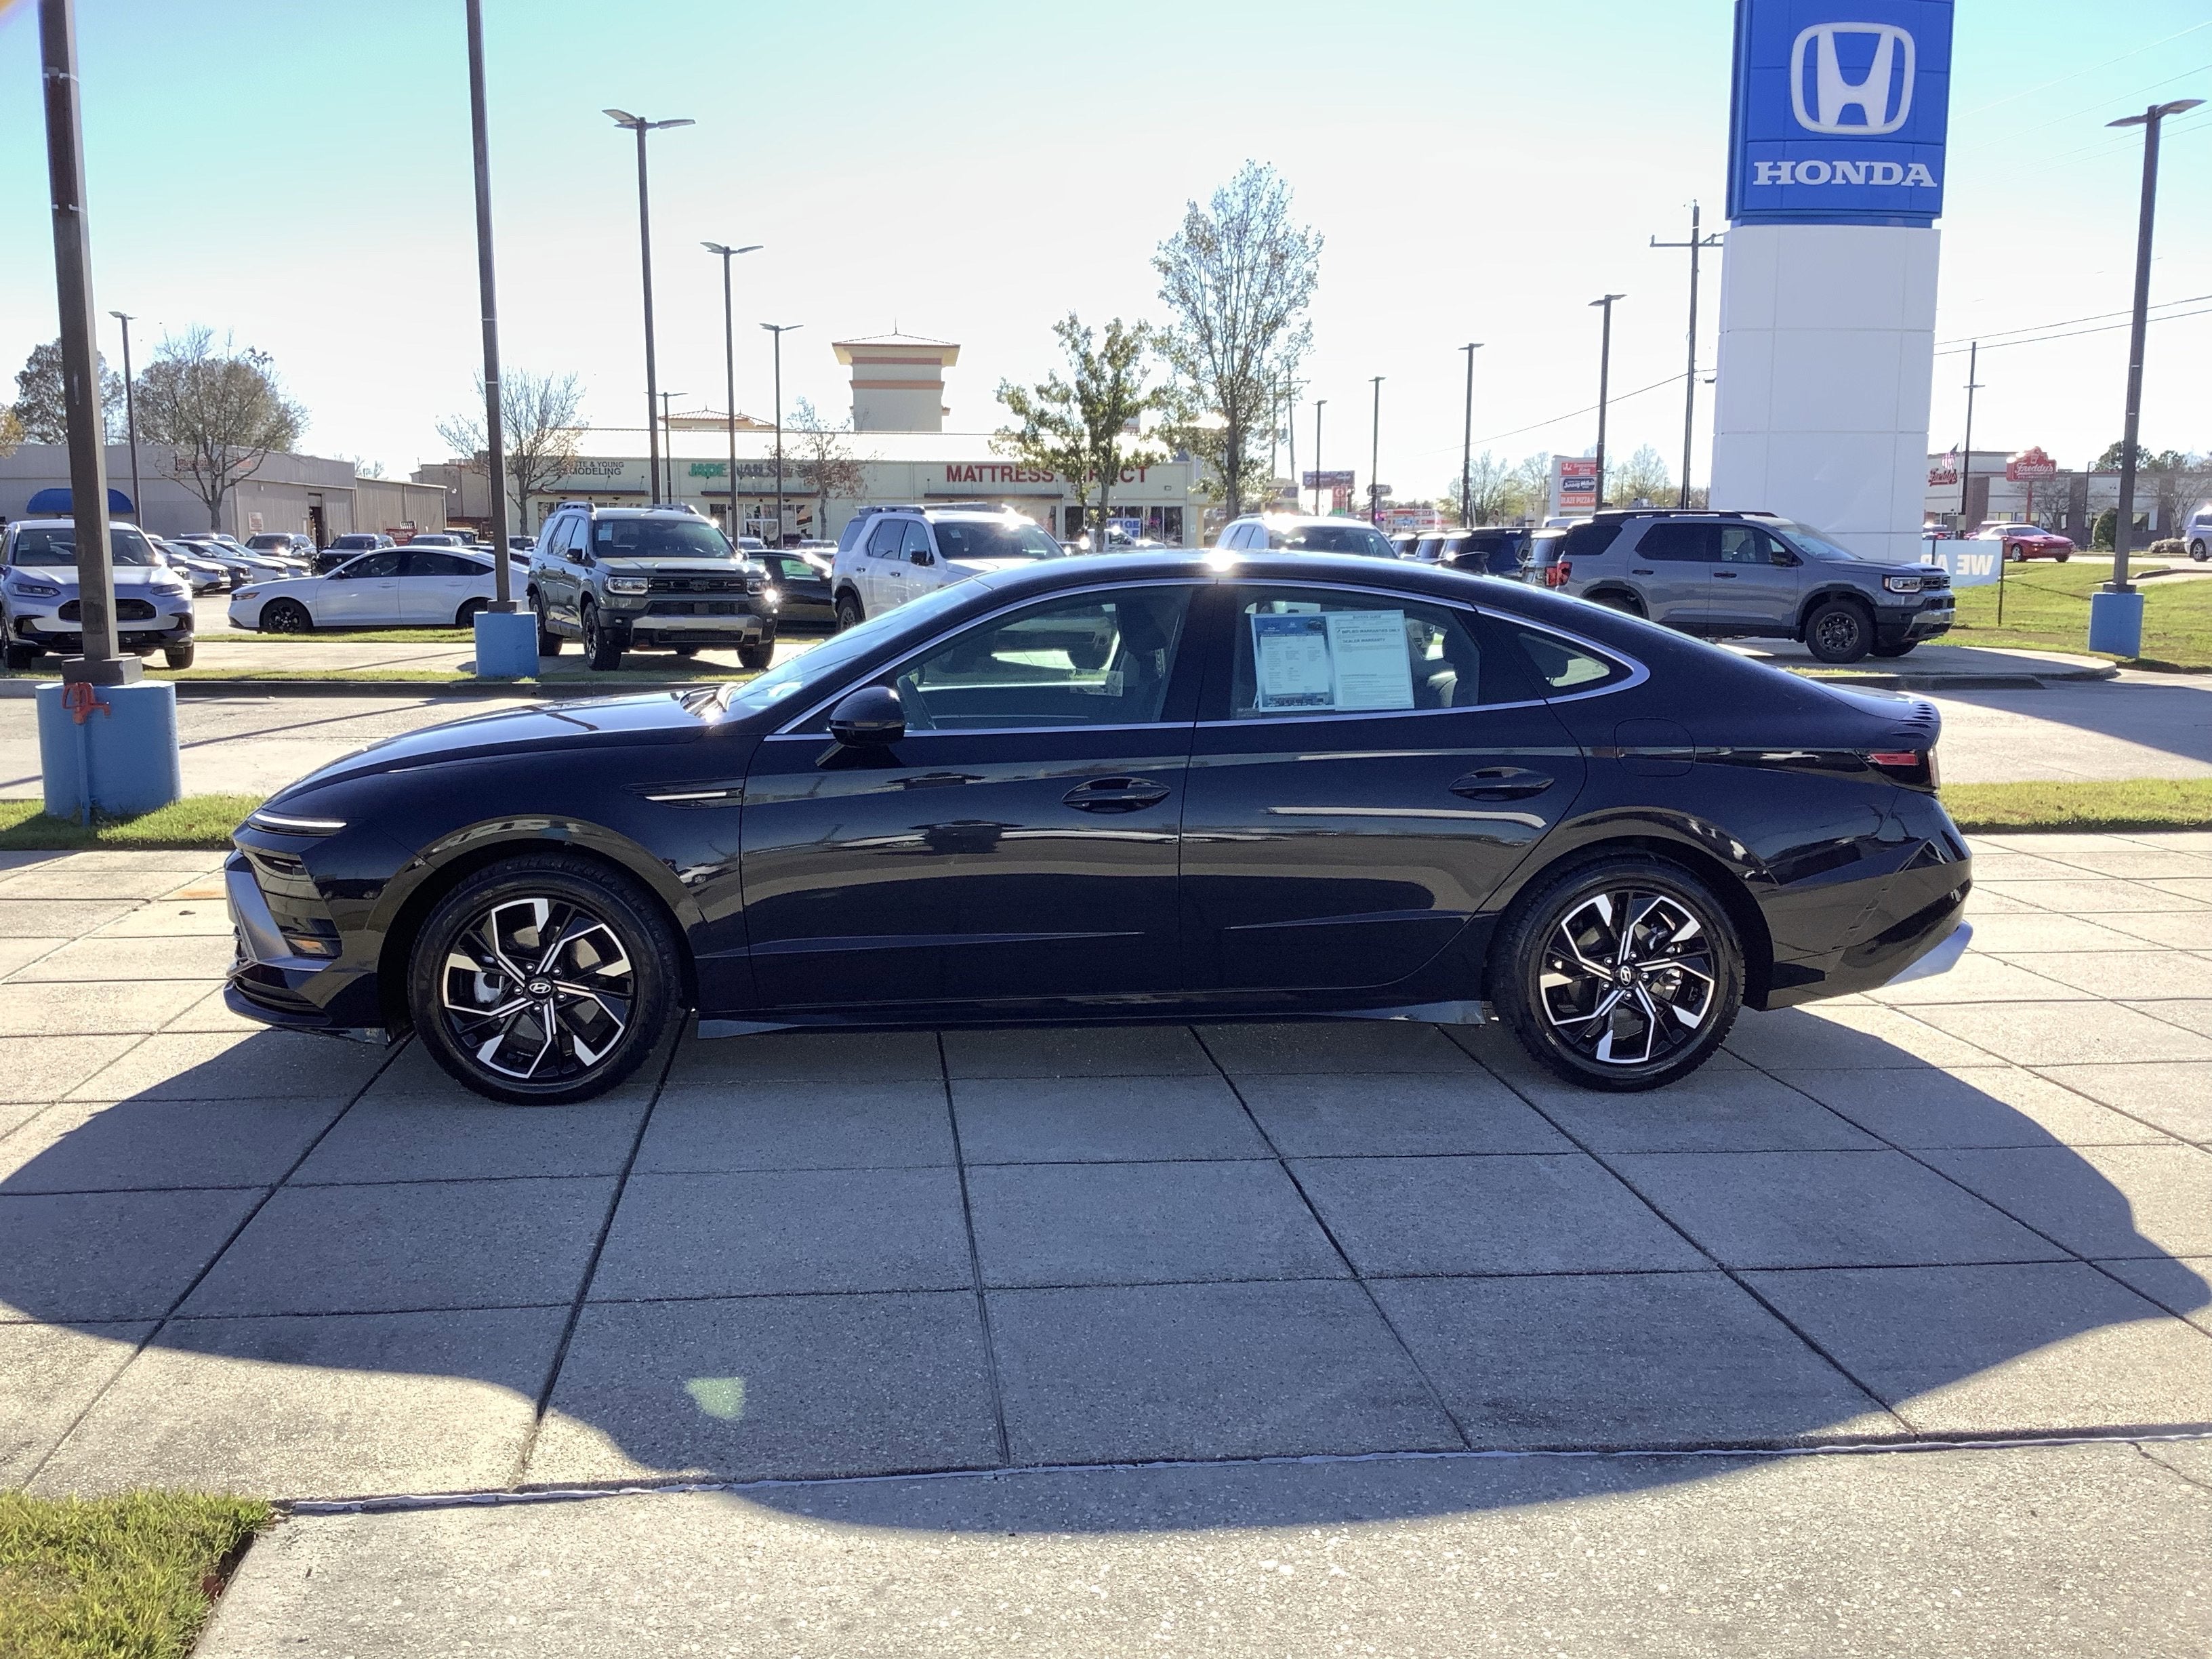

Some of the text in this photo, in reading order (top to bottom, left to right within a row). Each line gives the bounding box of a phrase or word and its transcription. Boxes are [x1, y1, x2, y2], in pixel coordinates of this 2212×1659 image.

[1753, 160, 1938, 188] HONDA
[561, 468, 621, 476] MODELING
[945, 465, 1054, 483] MATTRESS
[2014, 462, 2054, 474] Freddy's
